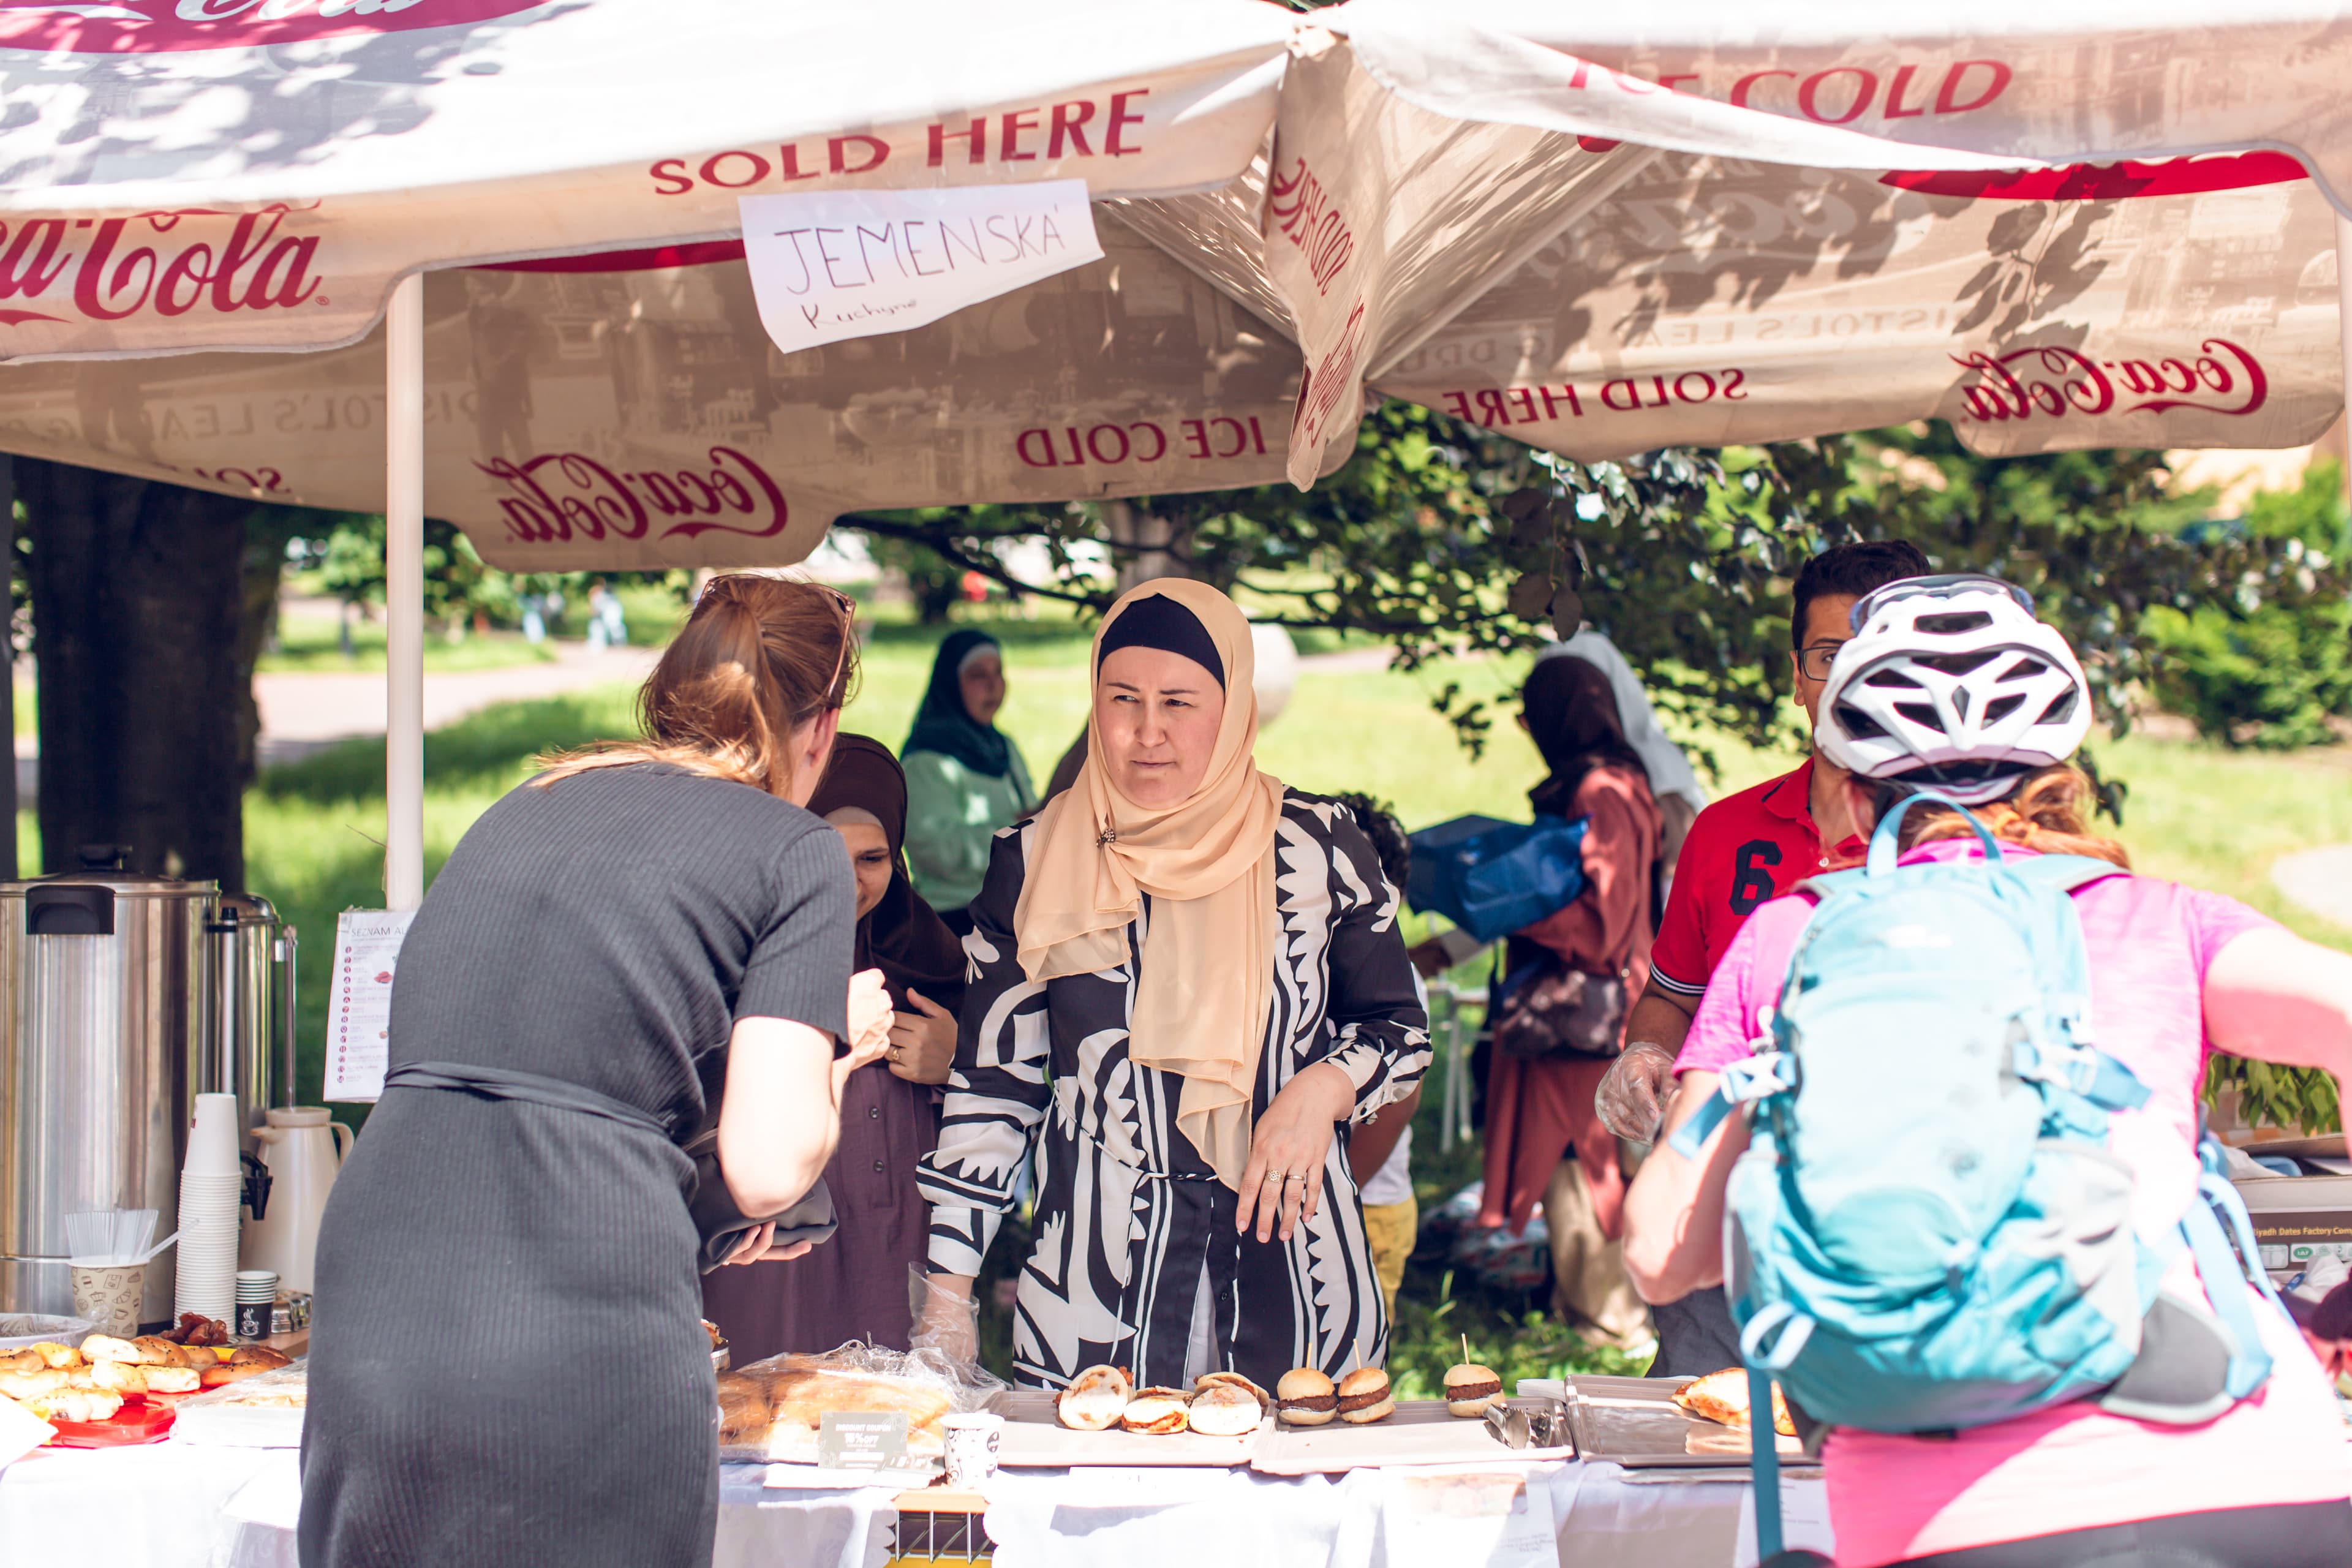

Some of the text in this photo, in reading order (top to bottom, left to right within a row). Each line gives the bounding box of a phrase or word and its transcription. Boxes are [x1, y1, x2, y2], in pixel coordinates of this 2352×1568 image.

[1730, 60, 2012, 124] COLD
[649, 88, 1150, 195] SOLD HERE
[1728, 839, 1782, 916] 6
[352, 926, 391, 937] SEZNAM
[2278, 1227, 2302, 1235] Dates
[2302, 1226, 2332, 1236] Factory
[866, 1423, 892, 1432] COUPON
